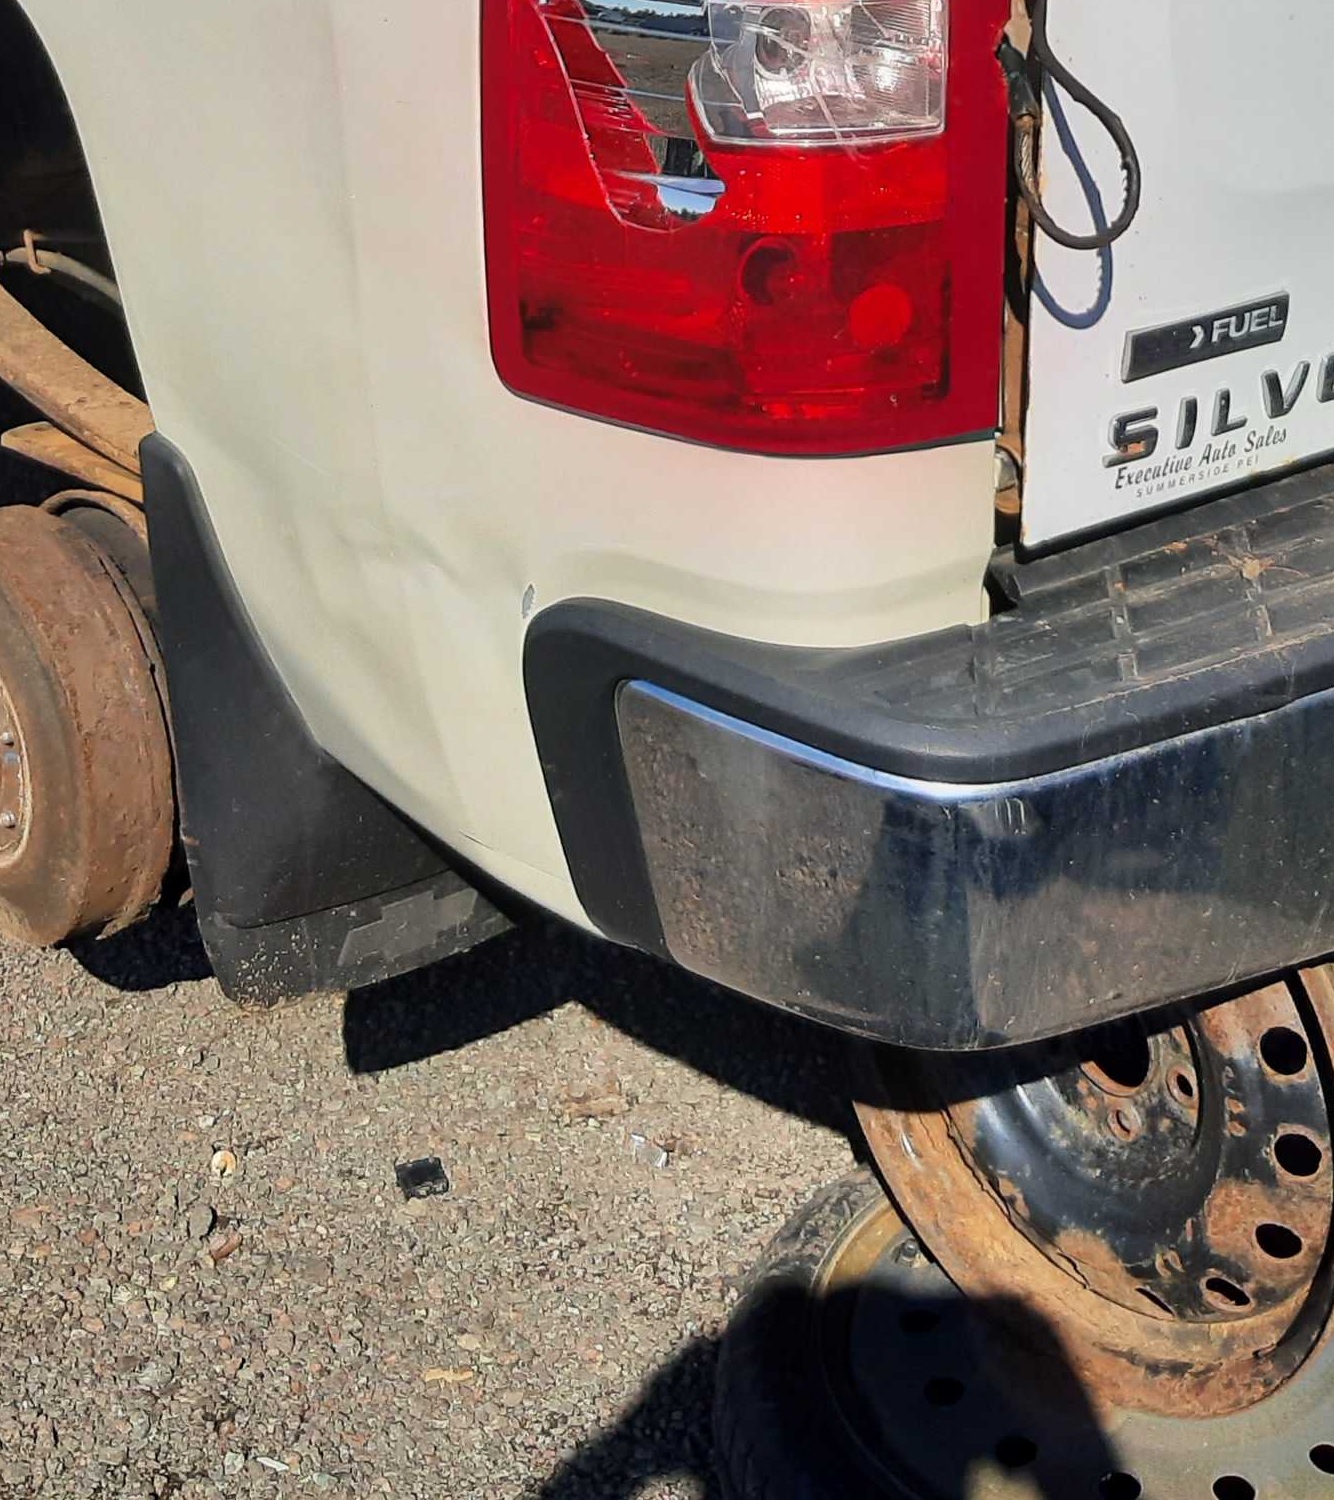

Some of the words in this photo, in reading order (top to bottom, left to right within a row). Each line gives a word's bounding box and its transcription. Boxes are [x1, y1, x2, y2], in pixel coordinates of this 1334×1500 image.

[1211, 305, 1284, 344] FUEL
[1115, 454, 1193, 489] Executive
[1197, 440, 1237, 468] Auto
[1244, 425, 1287, 452] Sales
[1136, 465, 1230, 498] SUMMERSIDE
[1237, 456, 1260, 469] PEI
